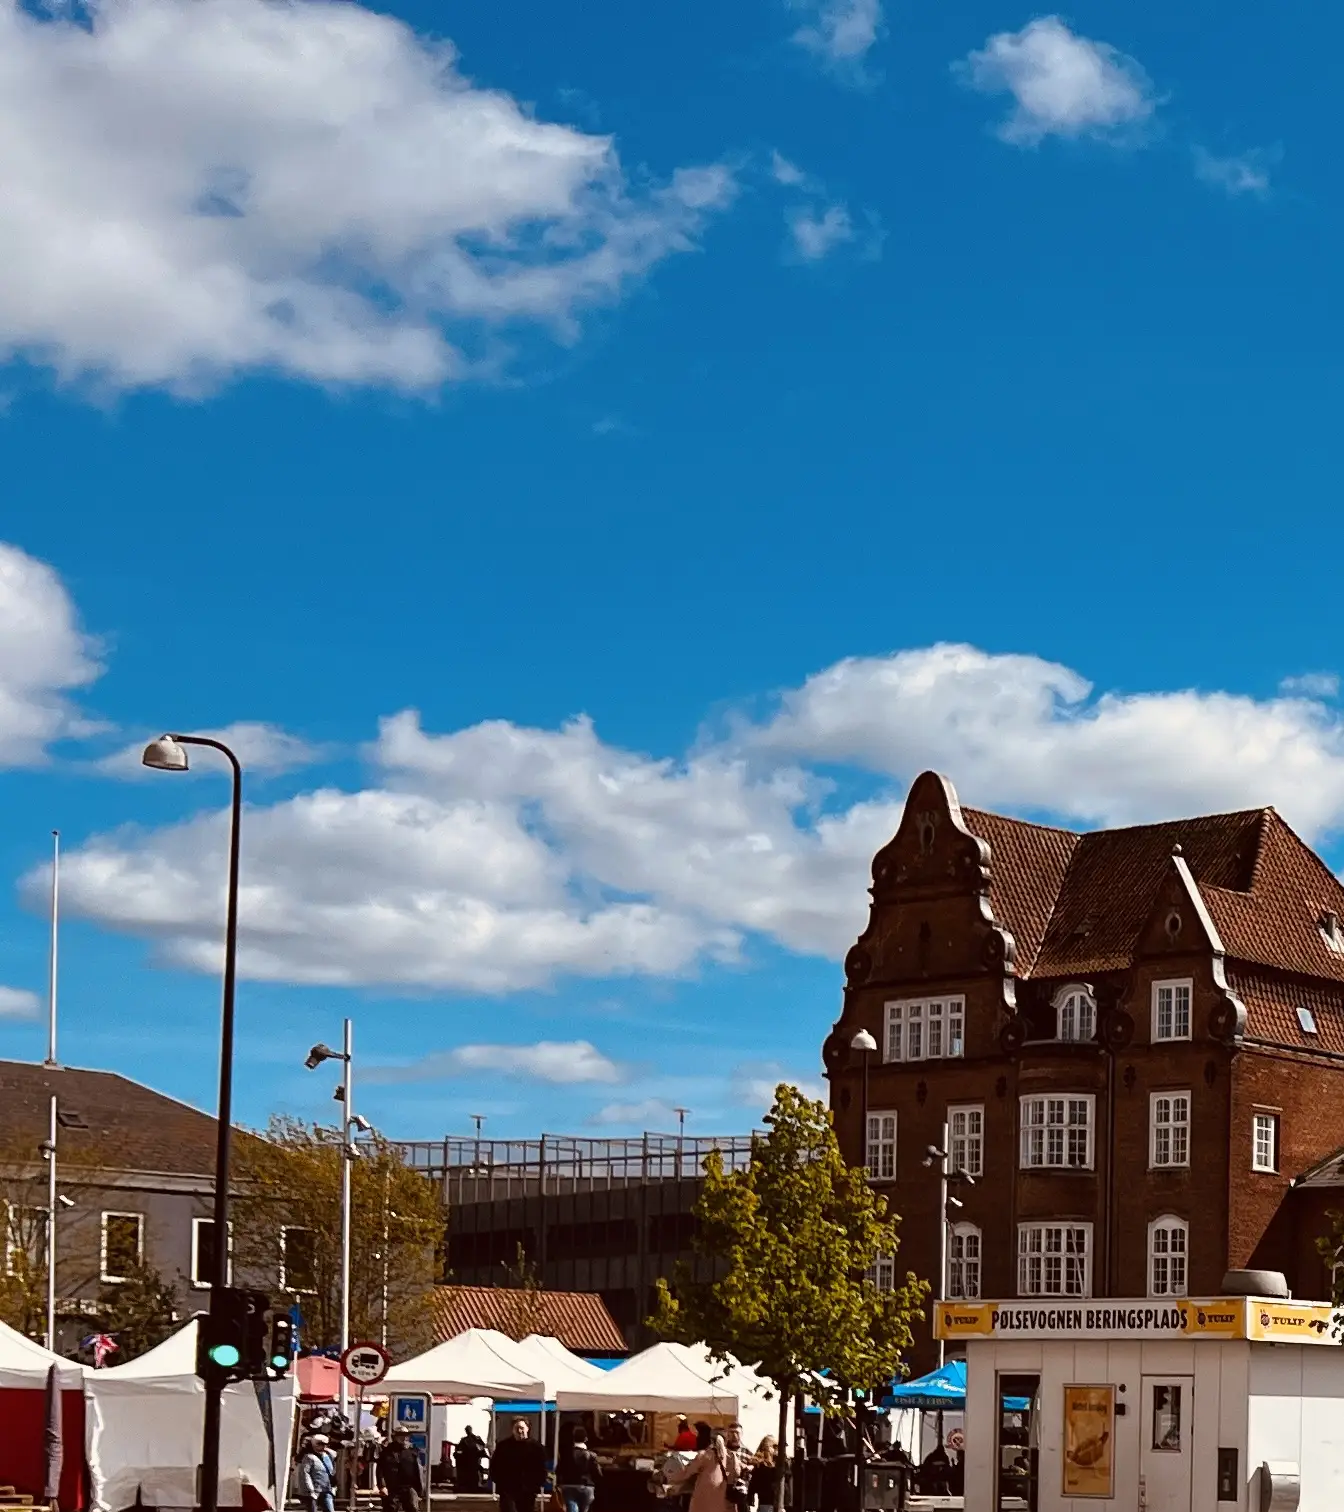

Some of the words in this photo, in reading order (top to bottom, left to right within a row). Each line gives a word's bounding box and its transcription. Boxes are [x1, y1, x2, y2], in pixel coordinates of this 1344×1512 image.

[991, 1309, 1082, 1330] PØLSEVOGNEN
[1085, 1308, 1188, 1330] BERINGSPLADS
[1207, 1314, 1237, 1323] TULIP
[1272, 1316, 1305, 1326] TULIP
